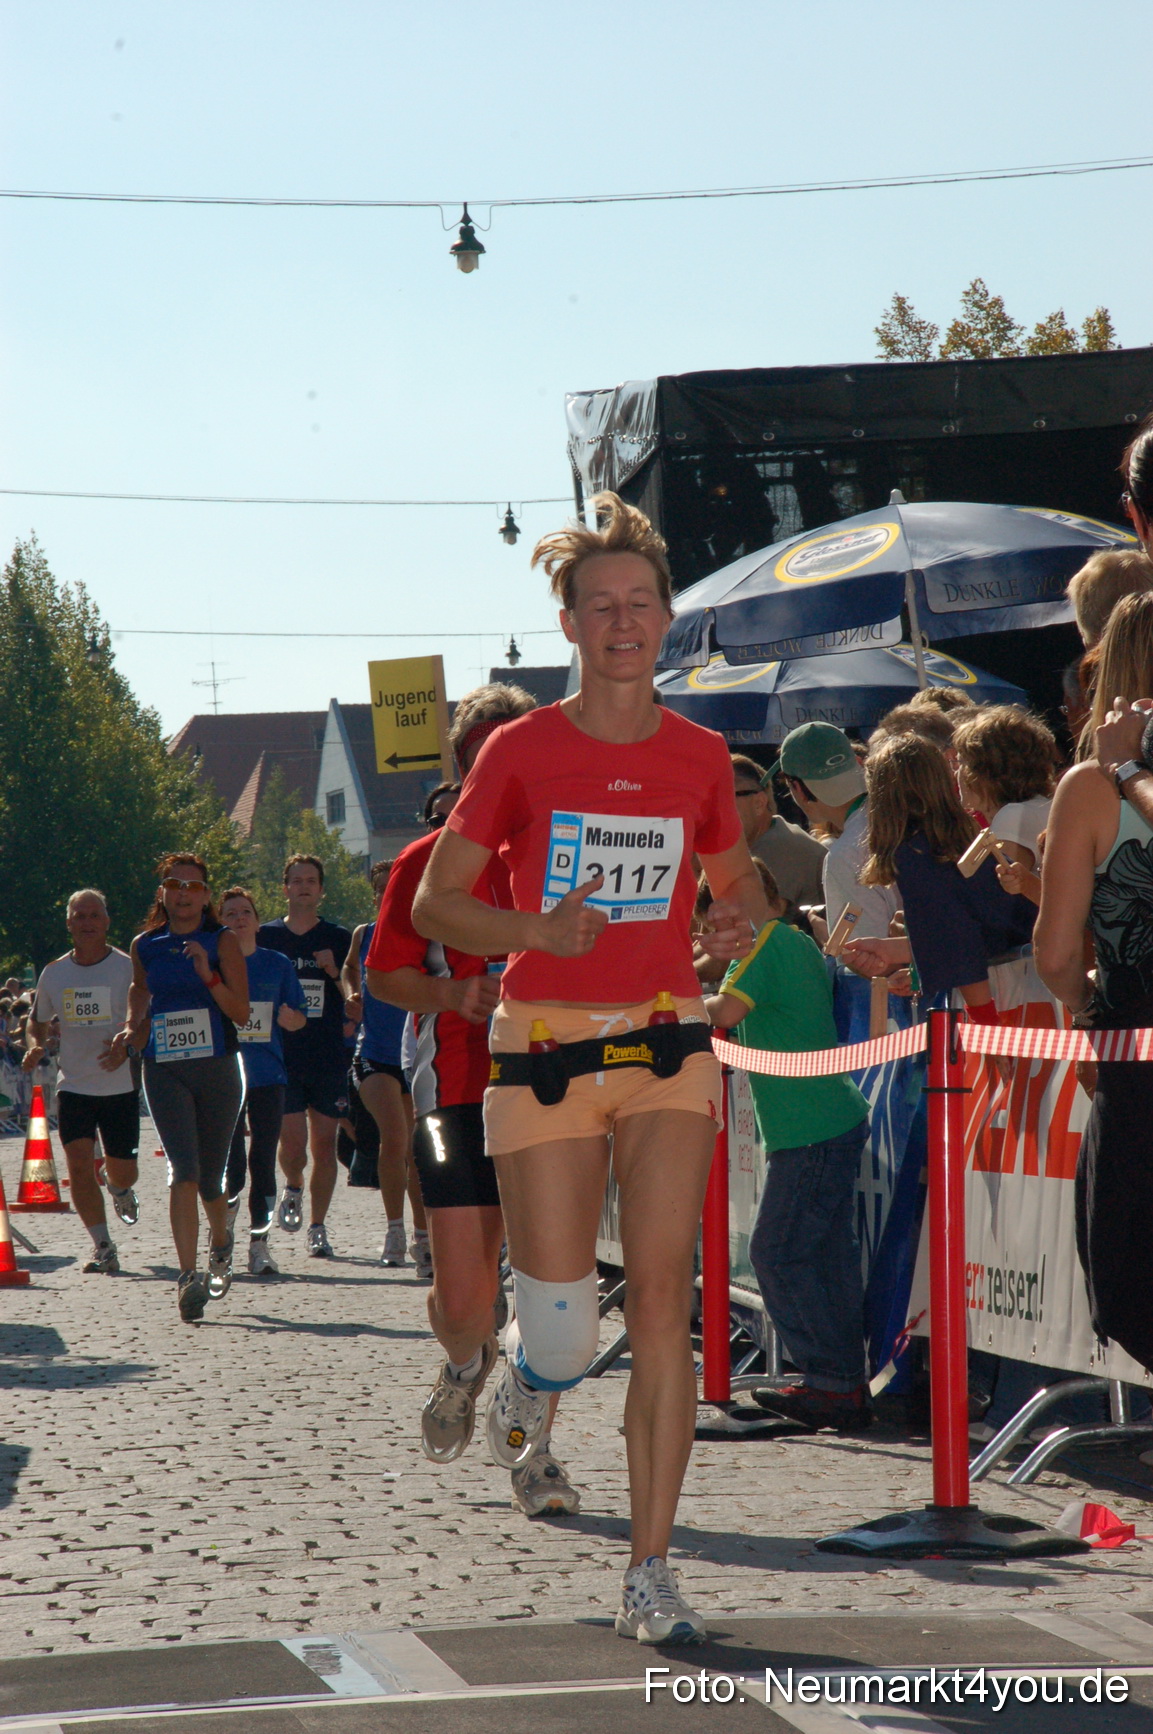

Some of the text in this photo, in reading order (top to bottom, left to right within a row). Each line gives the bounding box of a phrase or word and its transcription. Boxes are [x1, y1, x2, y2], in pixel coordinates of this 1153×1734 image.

[943, 579, 1021, 603] DUNKLE
[374, 686, 437, 710] Jugend
[395, 708, 427, 727] lauf
[585, 827, 665, 848] Manuela
[556, 853, 571, 869] D
[76, 1003, 99, 1015] 688
[166, 1016, 194, 1027] Jasmin
[157, 1032, 163, 1040] C
[168, 1030, 206, 1047] 2901
[603, 1043, 654, 1060] PowerBa
